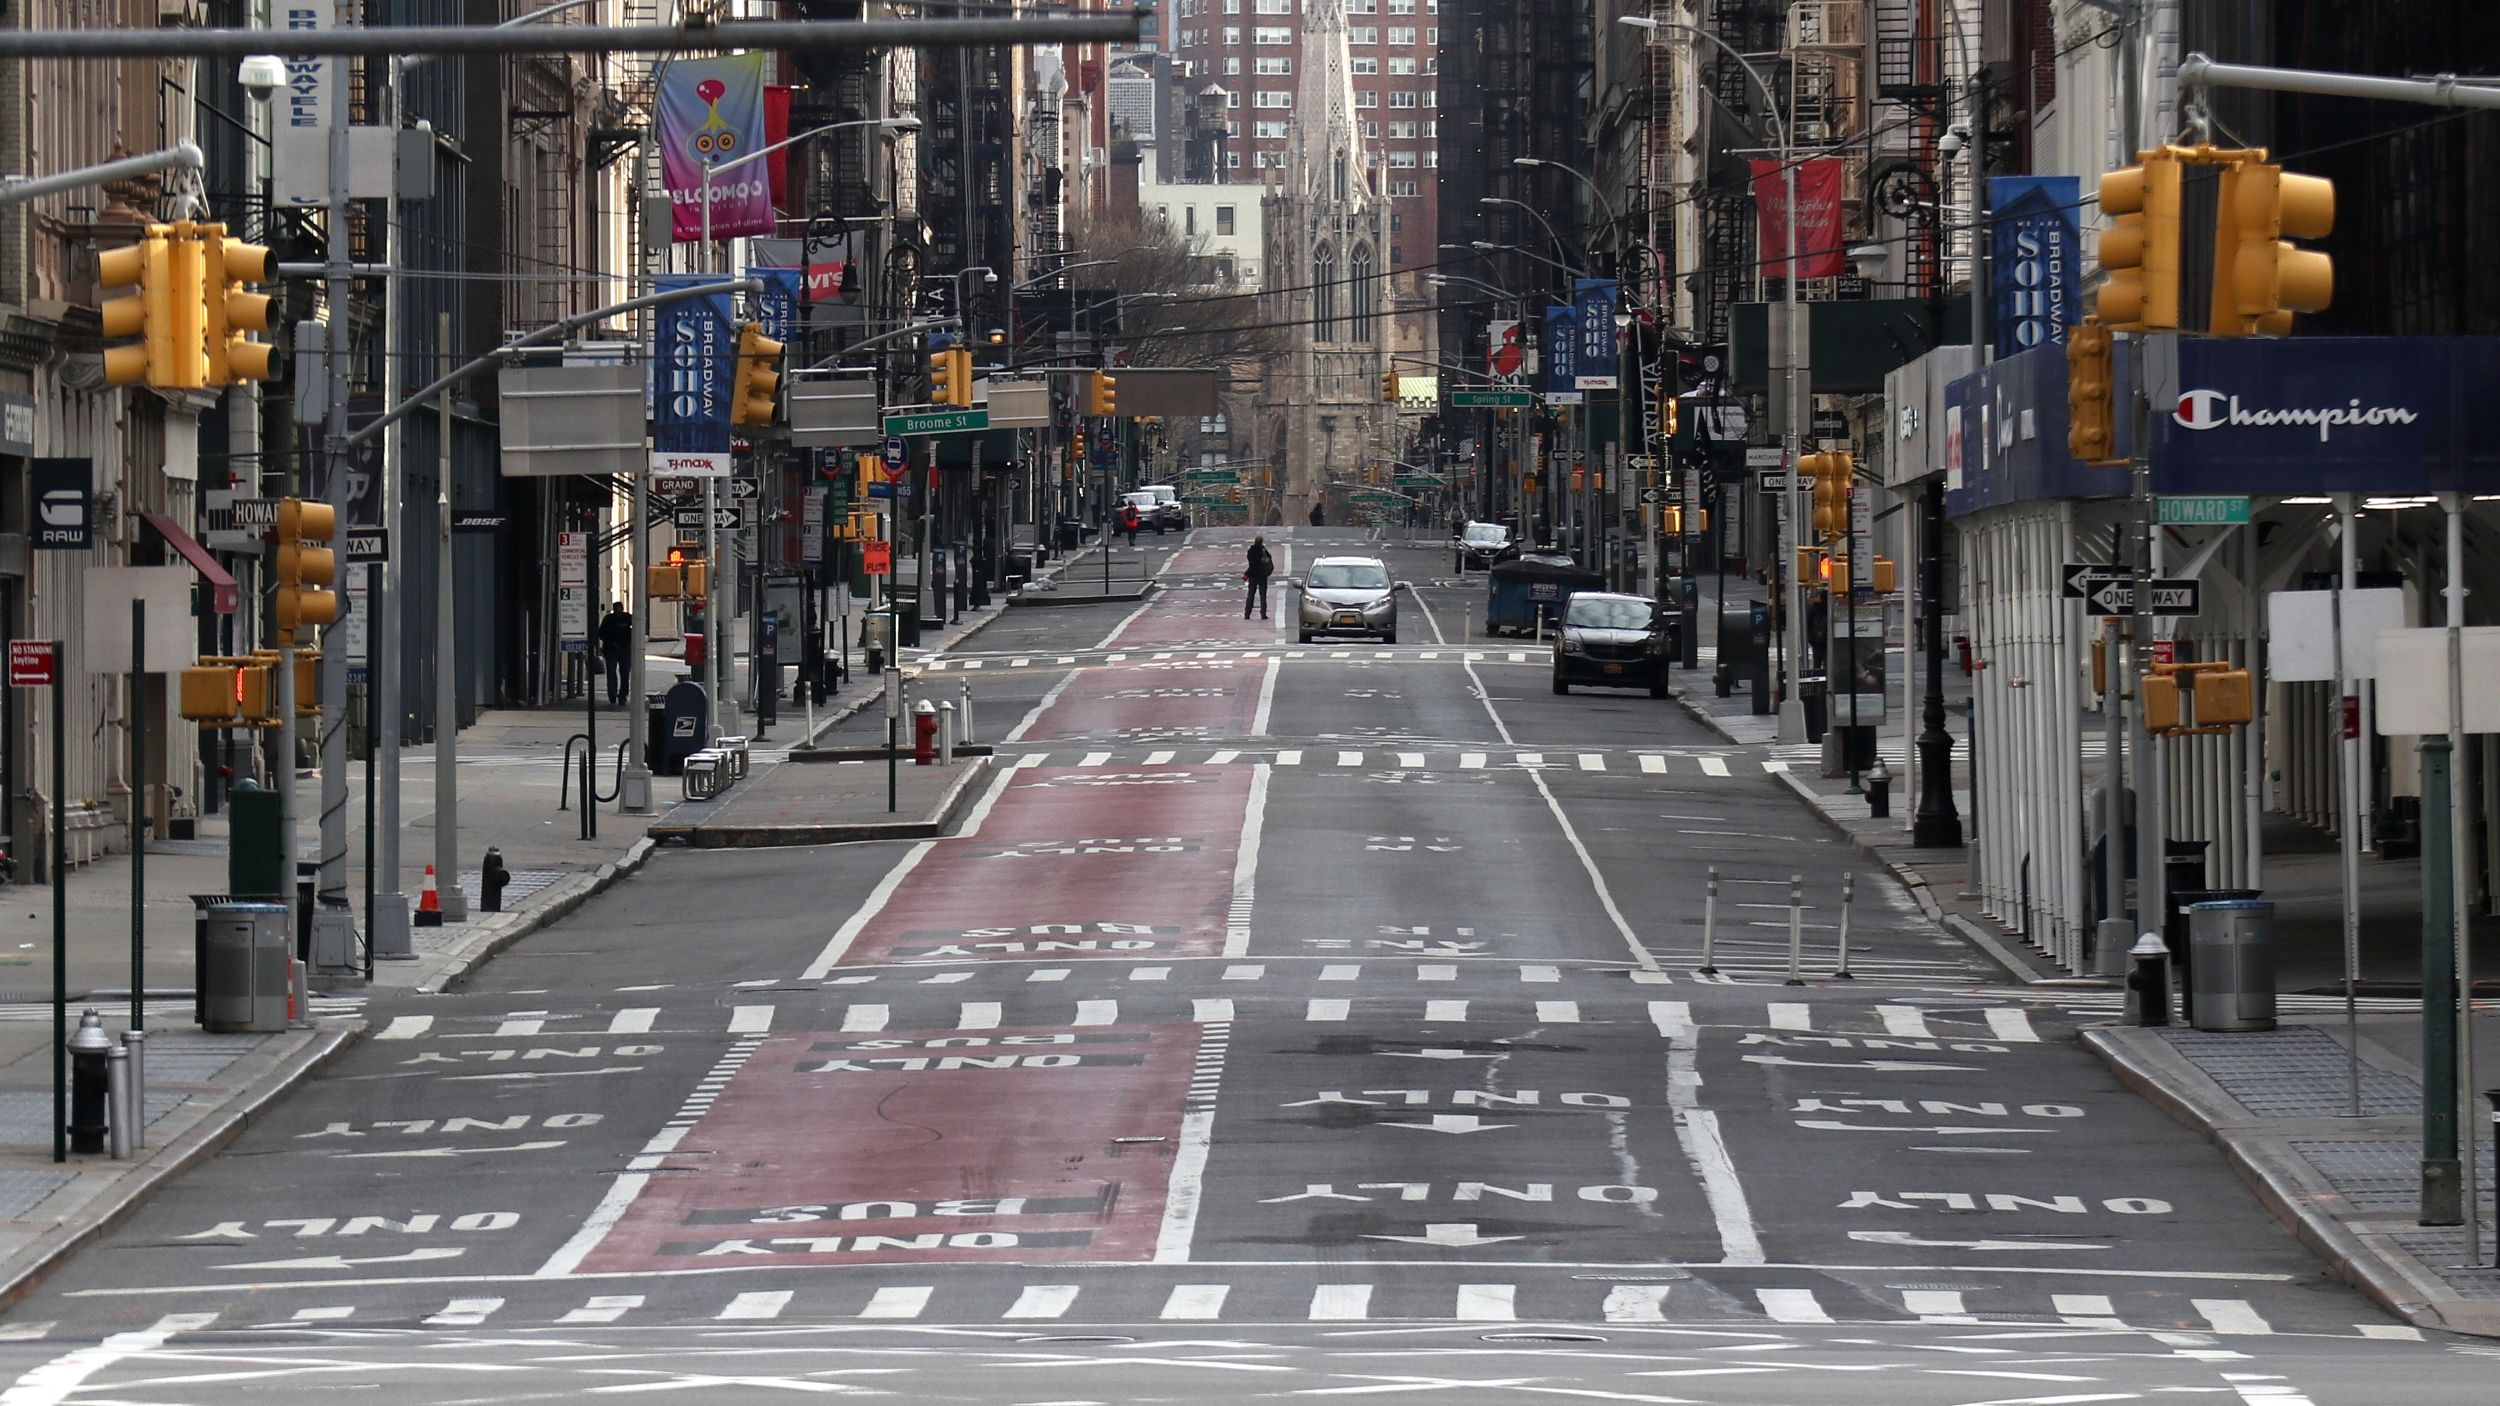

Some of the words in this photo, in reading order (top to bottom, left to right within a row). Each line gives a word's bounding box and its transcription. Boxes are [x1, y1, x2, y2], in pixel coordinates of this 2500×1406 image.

[2049, 231, 2063, 345] BROADWAY
[703, 320, 713, 418] BROADWAY
[1472, 395, 1500, 405] Spring
[1502, 395, 1512, 404] St
[907, 417, 951, 430] Broome
[956, 416, 968, 427] St
[2172, 389, 2418, 442] Champion
[662, 480, 694, 490] GRAND
[1768, 477, 1786, 486] ONE
[684, 513, 703, 525] ONE
[2158, 501, 2227, 522] HOWARD
[2231, 502, 2244, 512] ST
[455, 517, 506, 526] BOSE
[43, 531, 83, 542] RAW
[1685, 584, 1692, 594] P
[2103, 590, 2133, 605] ONE
[2152, 590, 2185, 605] WAY
[1755, 614, 1763, 625] P
[766, 624, 774, 635] P
[12, 645, 22, 655] NO
[13, 655, 40, 667] Anytime
[919, 939, 1155, 957] ONLY
[399, 1044, 665, 1065] ONLY
[816, 1054, 1082, 1073] ONLY
[1278, 1089, 1632, 1108] ONLY
[1789, 1098, 2086, 1118] ONLY
[293, 1112, 605, 1139] ONLY
[1257, 1181, 1659, 1203] ONLY
[750, 1198, 1028, 1225] BUS
[1836, 1191, 2174, 1215] ONLY
[172, 1210, 521, 1240] ONLY
[696, 1232, 1019, 1256] ONLY
